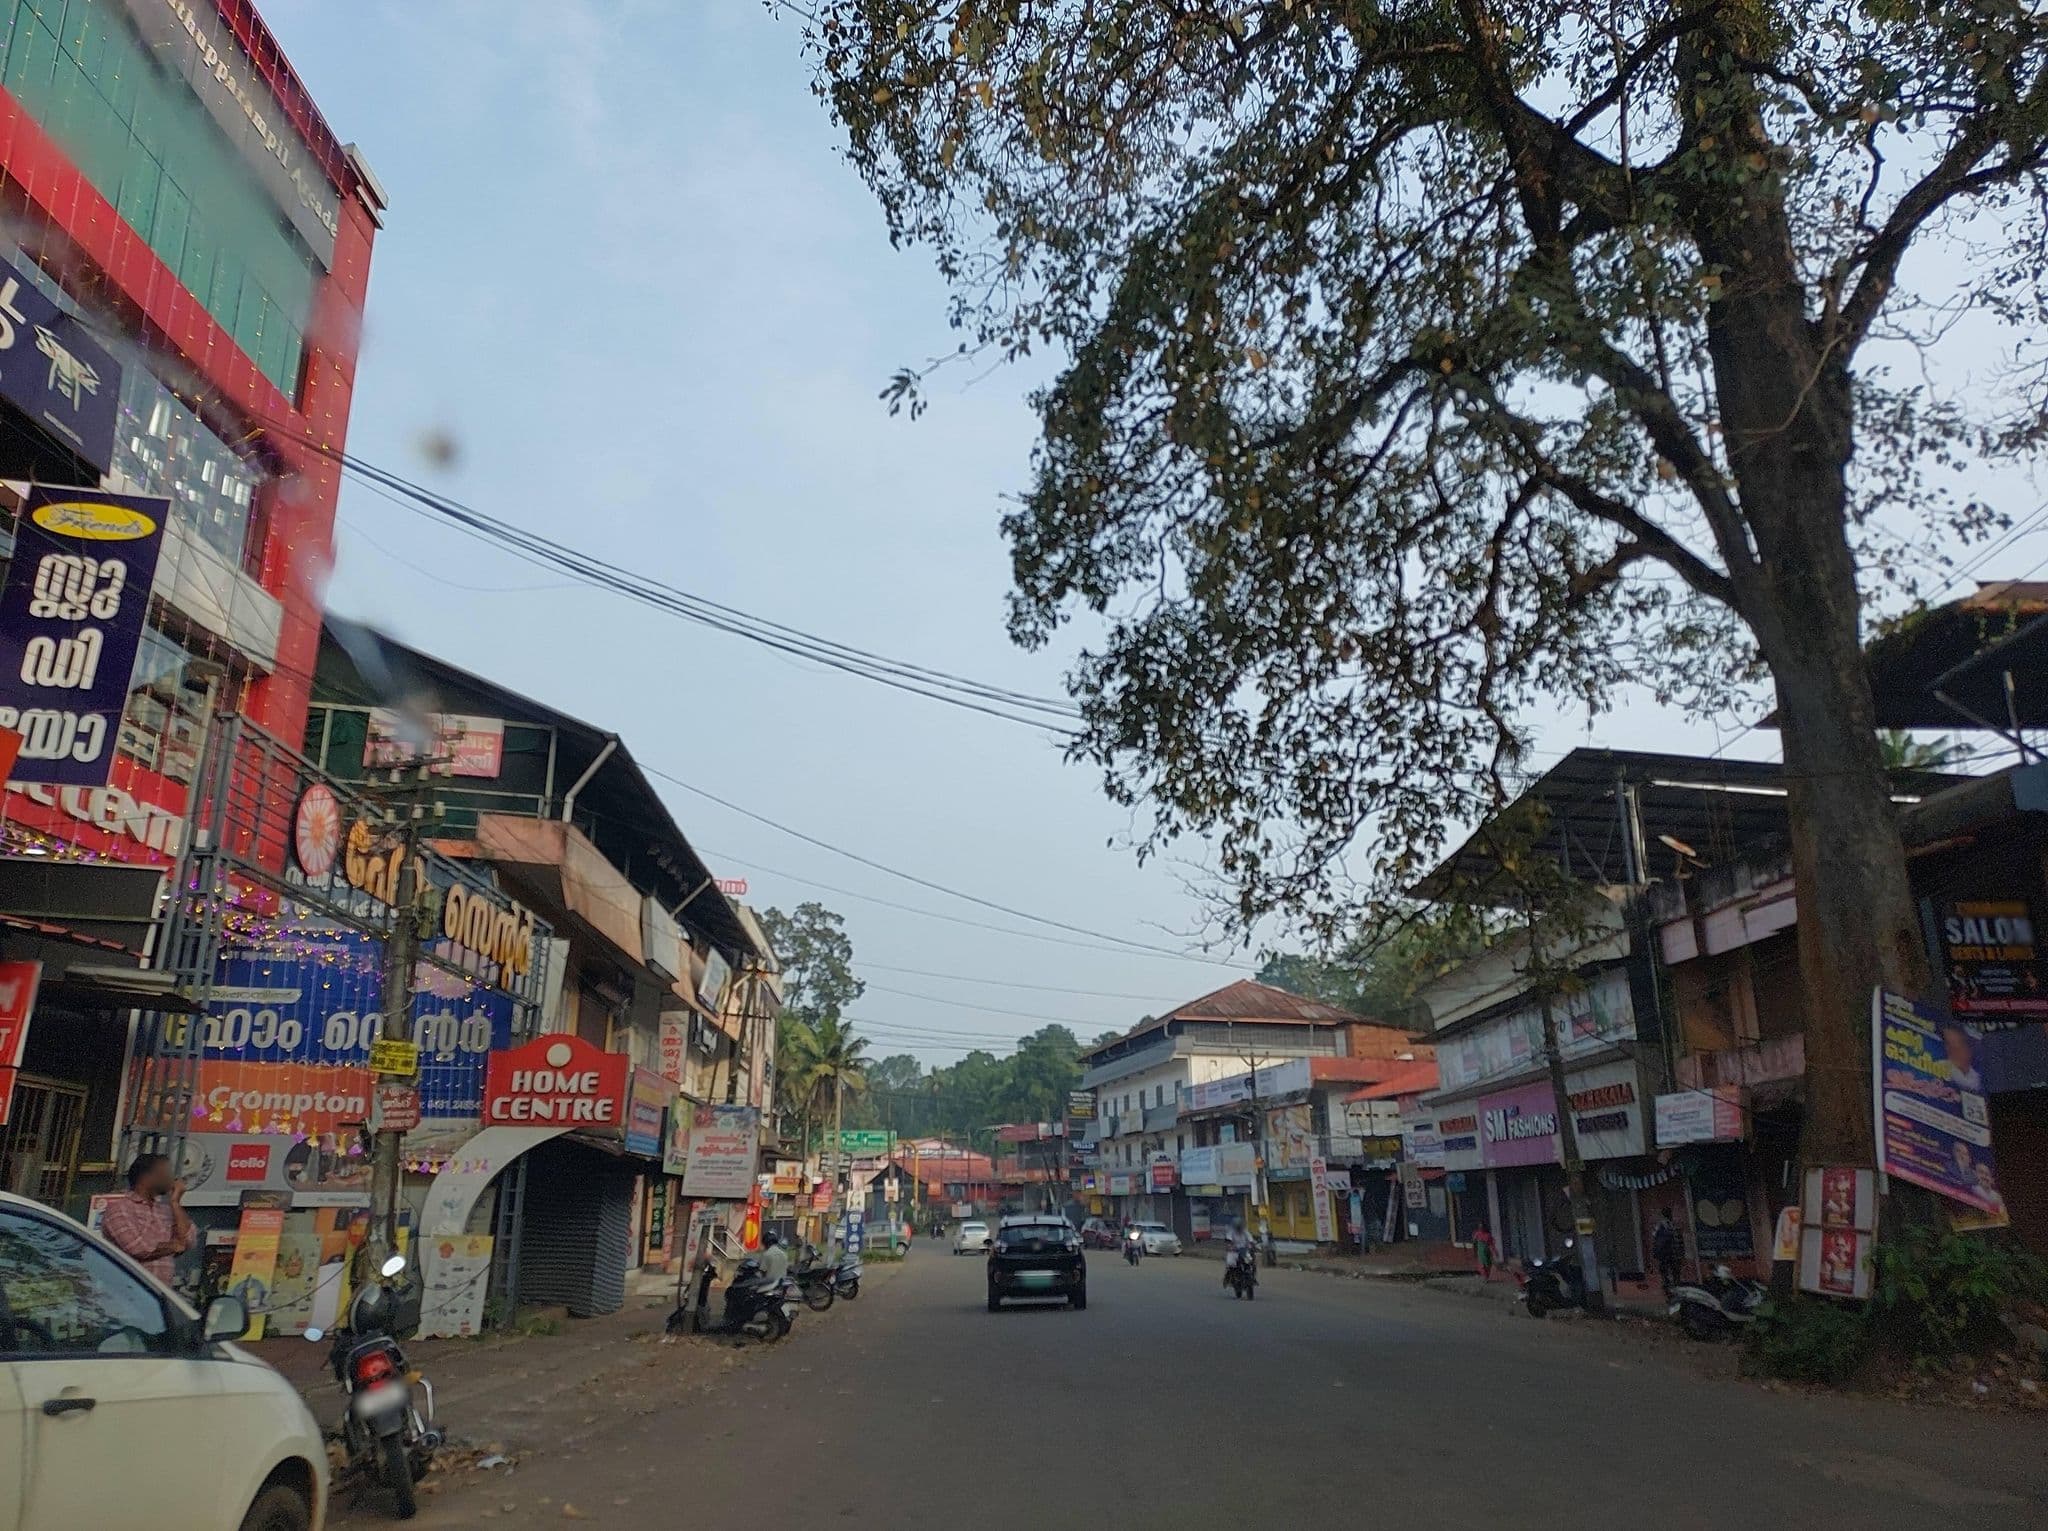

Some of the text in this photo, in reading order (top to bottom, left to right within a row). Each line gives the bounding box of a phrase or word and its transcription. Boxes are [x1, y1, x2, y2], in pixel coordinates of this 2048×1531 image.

[289, 168, 338, 238] Arcade
[512, 1071, 599, 1095] HOME
[209, 1086, 365, 1116] Crompton
[492, 1098, 614, 1122] CENTRE
[1485, 1108, 1508, 1143] SM
[1508, 1113, 1557, 1140] FASHIONS
[230, 1157, 266, 1168] cello
